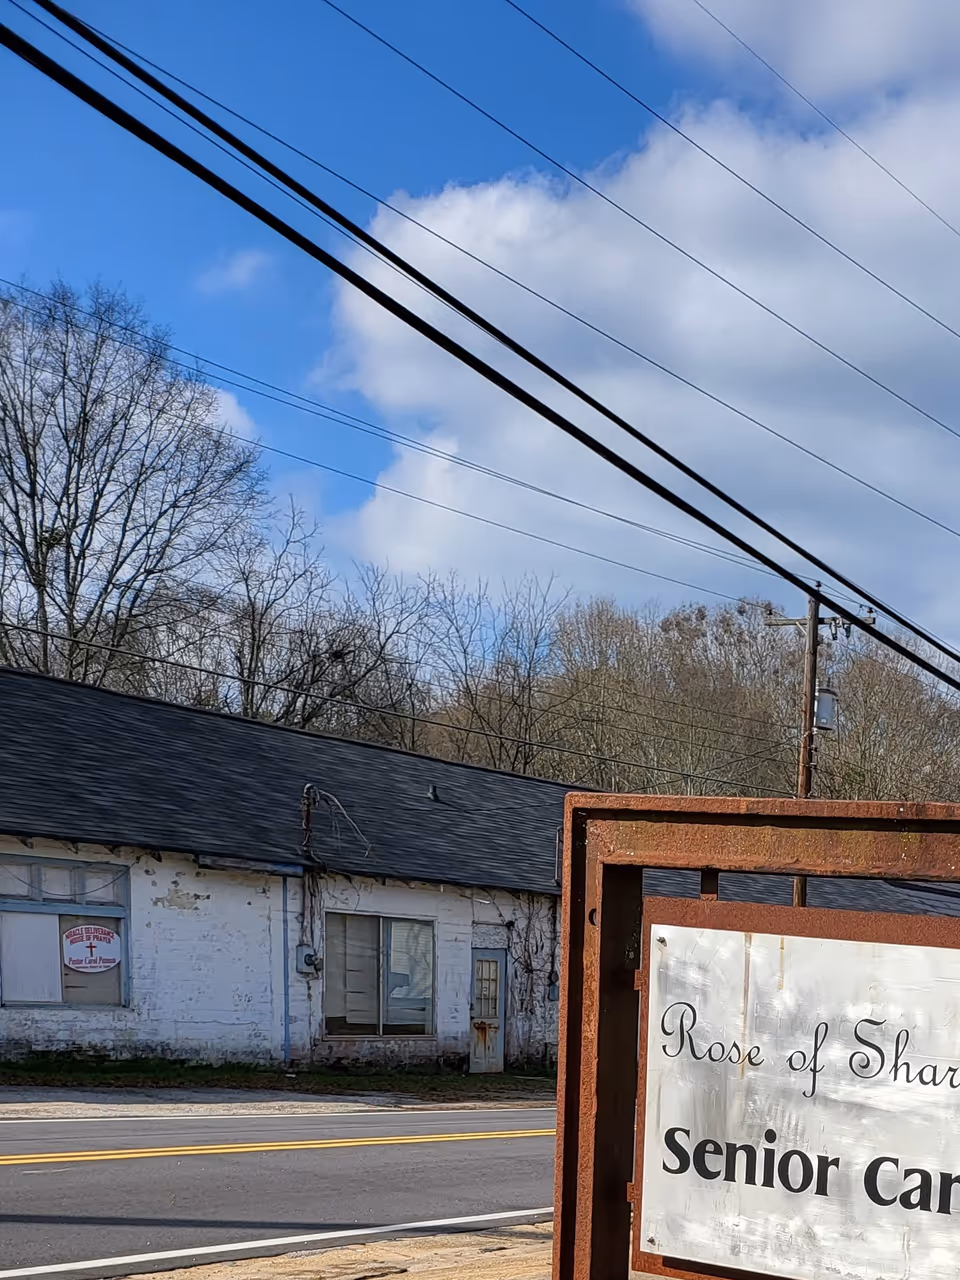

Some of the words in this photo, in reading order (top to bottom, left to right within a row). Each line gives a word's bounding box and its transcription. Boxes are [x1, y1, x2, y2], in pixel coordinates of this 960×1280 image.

[93, 935, 112, 944] PRAYER
[661, 1001, 765, 1067] Rose
[786, 1021, 829, 1098] of
[662, 1126, 840, 1197] Senior
